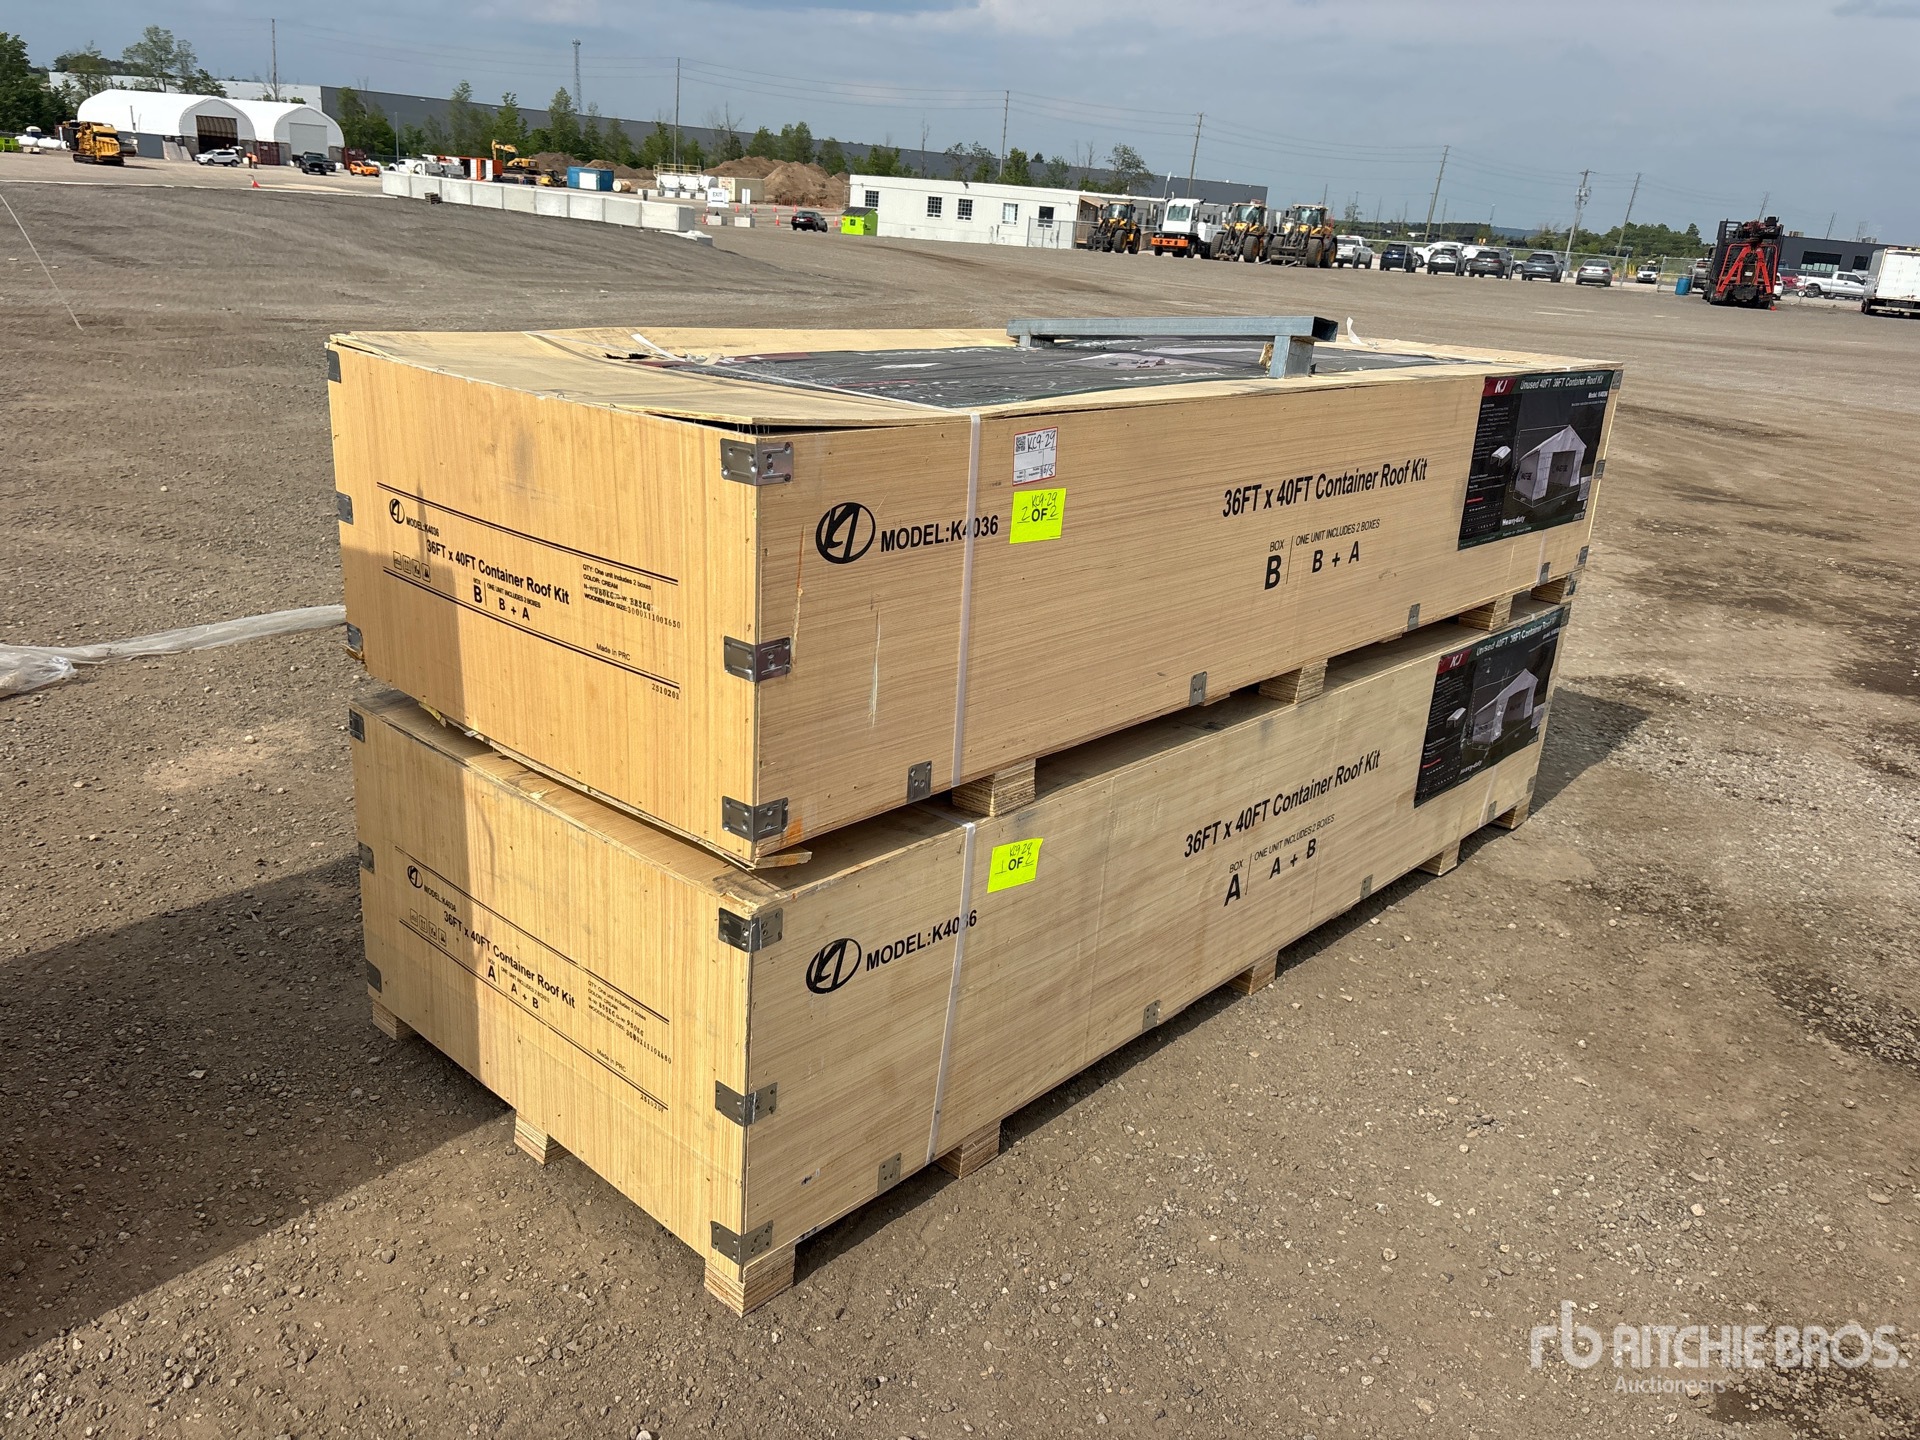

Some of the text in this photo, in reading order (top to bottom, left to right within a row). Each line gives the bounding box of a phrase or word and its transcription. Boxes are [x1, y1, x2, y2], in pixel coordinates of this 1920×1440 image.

[1494, 380, 1508, 394] KJ
[1222, 458, 1428, 517] 36FT x 40FT Container Roof Kit
[1031, 507, 1048, 522] OF
[1269, 518, 1380, 552] BOX ONE UNIT INCLUDES 2 BOXES
[426, 539, 570, 605] 36FT x 40FT Container Roof Kit
[1264, 554, 1282, 590] B
[1311, 549, 1324, 573] B
[1348, 540, 1360, 564] A
[473, 584, 483, 604] B
[498, 597, 506, 611] B
[522, 607, 530, 621] A
[596, 642, 611, 654] Made
[618, 650, 631, 661] PRC
[1449, 653, 1463, 669] KJ
[1184, 749, 1381, 858] 36FT x 40FT Container Roof Kit
[1229, 859, 1244, 873] BOX
[1254, 847, 1268, 861] ONE
[1268, 840, 1283, 855] UNIT
[1283, 826, 1312, 846] INCLUDES
[1316, 813, 1335, 830] BOXES
[1269, 856, 1281, 880] A
[1306, 838, 1317, 860] B
[1008, 856, 1024, 871] OF
[1223, 873, 1241, 907] A
[443, 910, 576, 1009] 36FT x 40FT Container Roof Kit
[488, 965, 497, 983] A
[511, 982, 518, 996] A
[532, 996, 539, 1010] B
